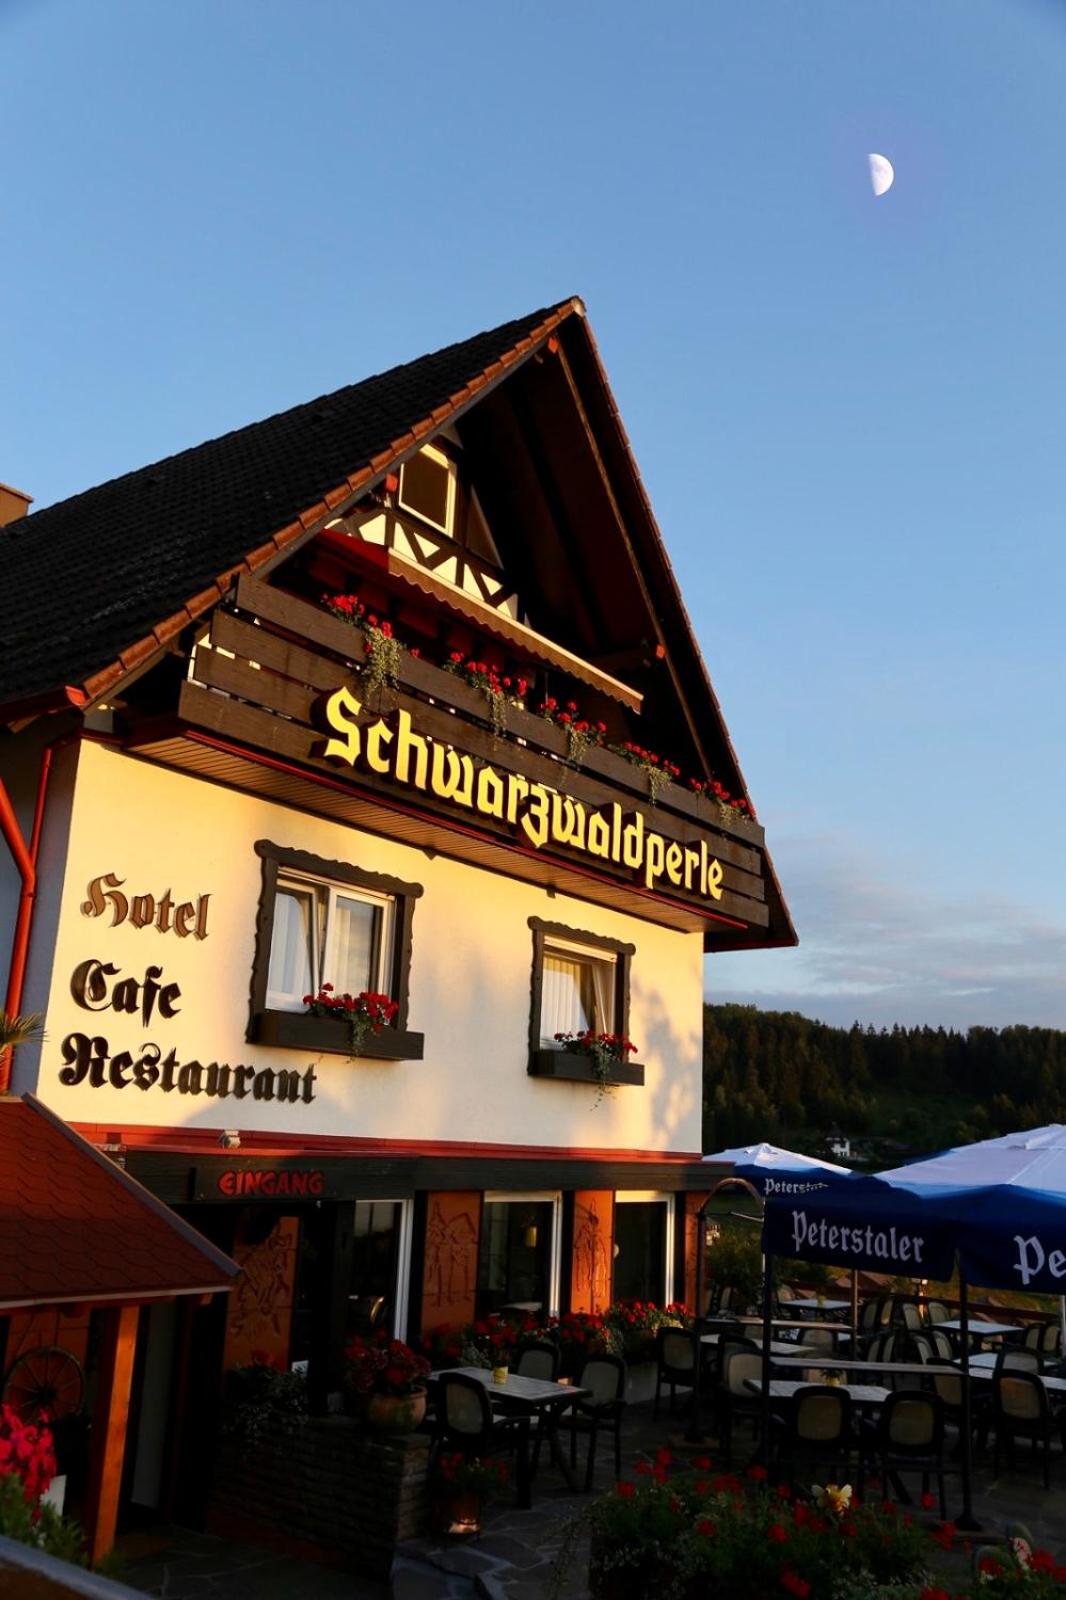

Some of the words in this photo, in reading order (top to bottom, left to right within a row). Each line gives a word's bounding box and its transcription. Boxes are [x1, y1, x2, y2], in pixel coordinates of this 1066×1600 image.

[325, 686, 724, 900] Schwarzwaldperle
[81, 872, 212, 940] Hotel
[70, 959, 182, 1027] Cafe
[59, 1032, 317, 1104] Restaurant
[218, 1169, 325, 1195] EINGANG
[792, 1210, 924, 1263] Peterstaler
